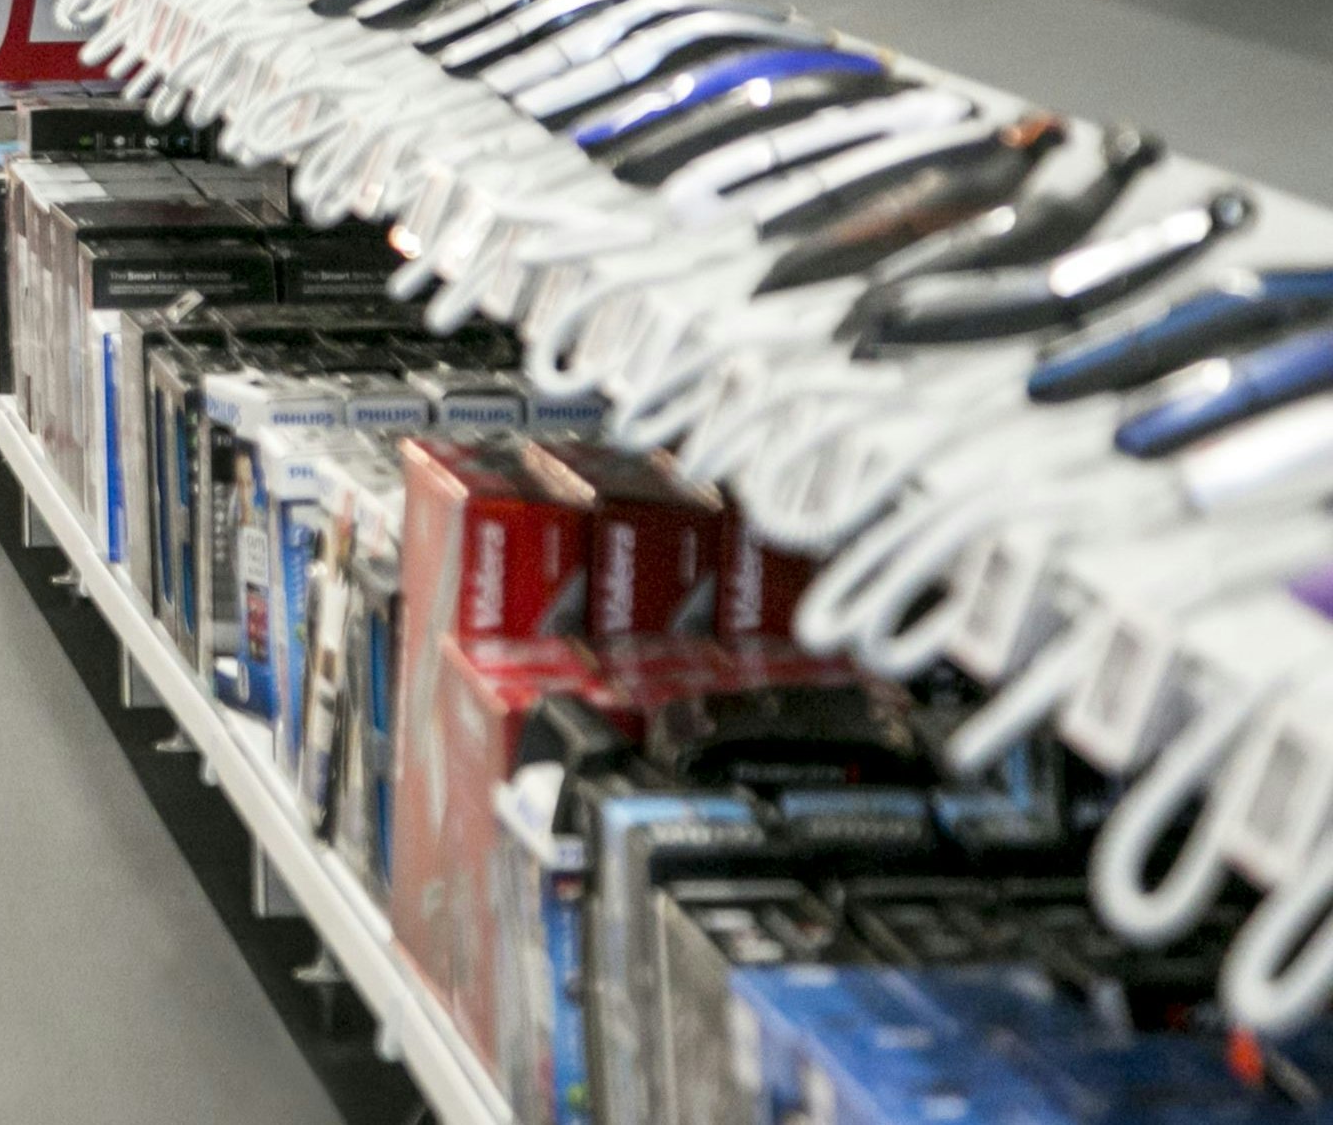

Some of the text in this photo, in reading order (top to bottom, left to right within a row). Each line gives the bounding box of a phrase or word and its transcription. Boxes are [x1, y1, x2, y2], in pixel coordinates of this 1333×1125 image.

[127, 271, 156, 280] Smart
[271, 412, 334, 428] PHILIPS
[356, 408, 422, 424] PHILIPS
[448, 408, 515, 425] PHILIPS
